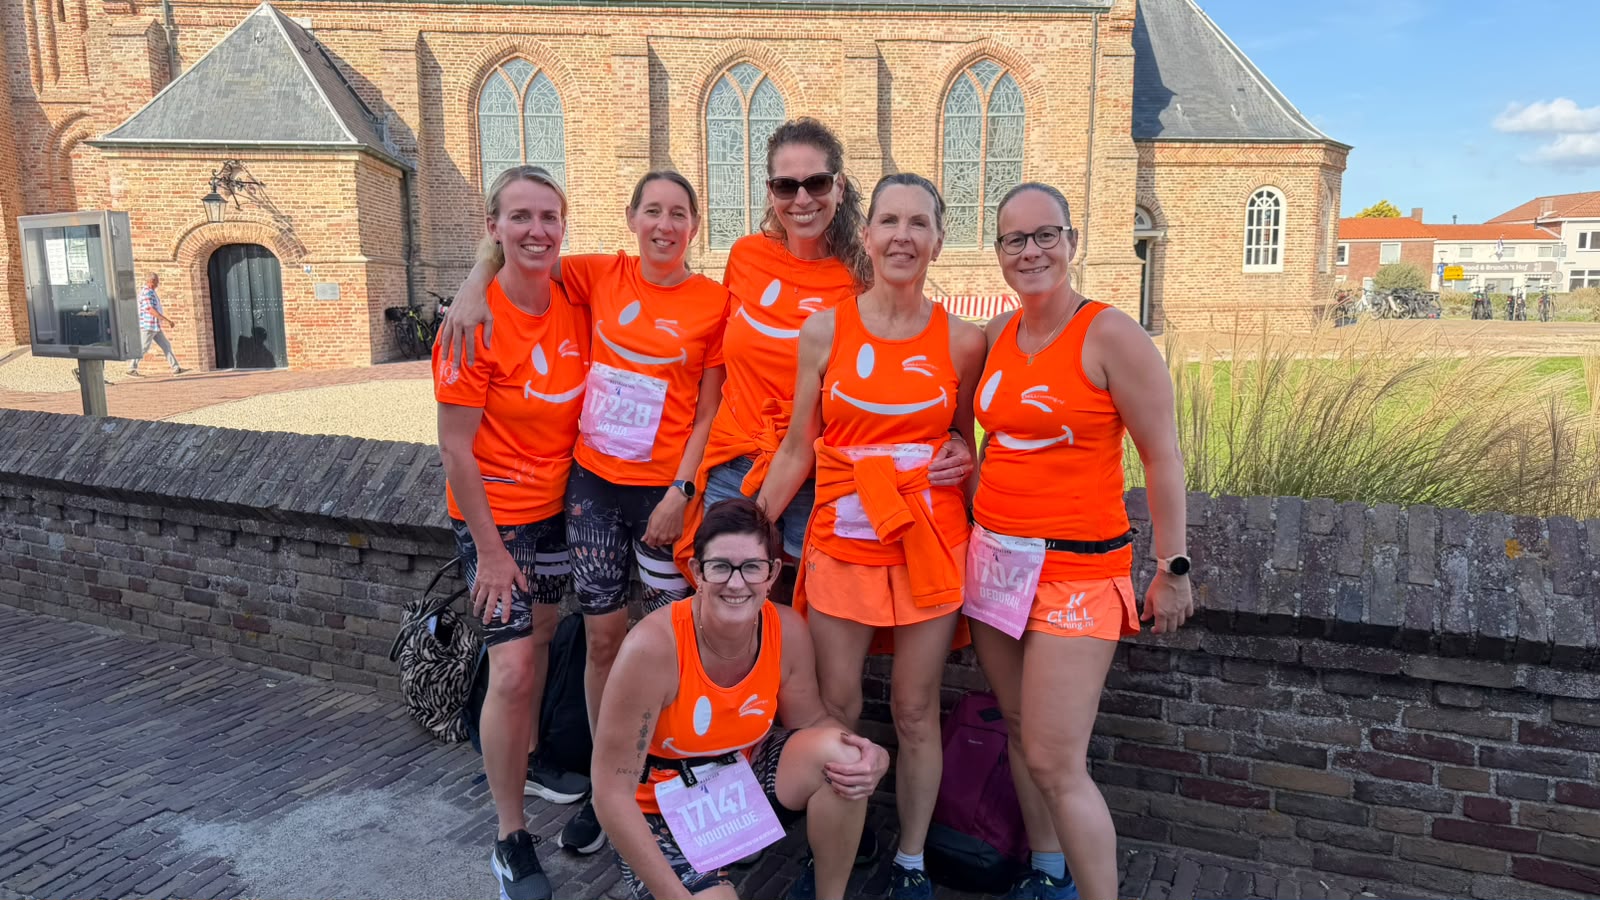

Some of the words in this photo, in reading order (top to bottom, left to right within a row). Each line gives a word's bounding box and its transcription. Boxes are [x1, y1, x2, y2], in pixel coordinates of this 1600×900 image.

[589, 389, 652, 428] 17228
[596, 420, 628, 436] KATJA
[677, 780, 749, 833] 17147
[694, 810, 759, 848] WOUTHILDE
